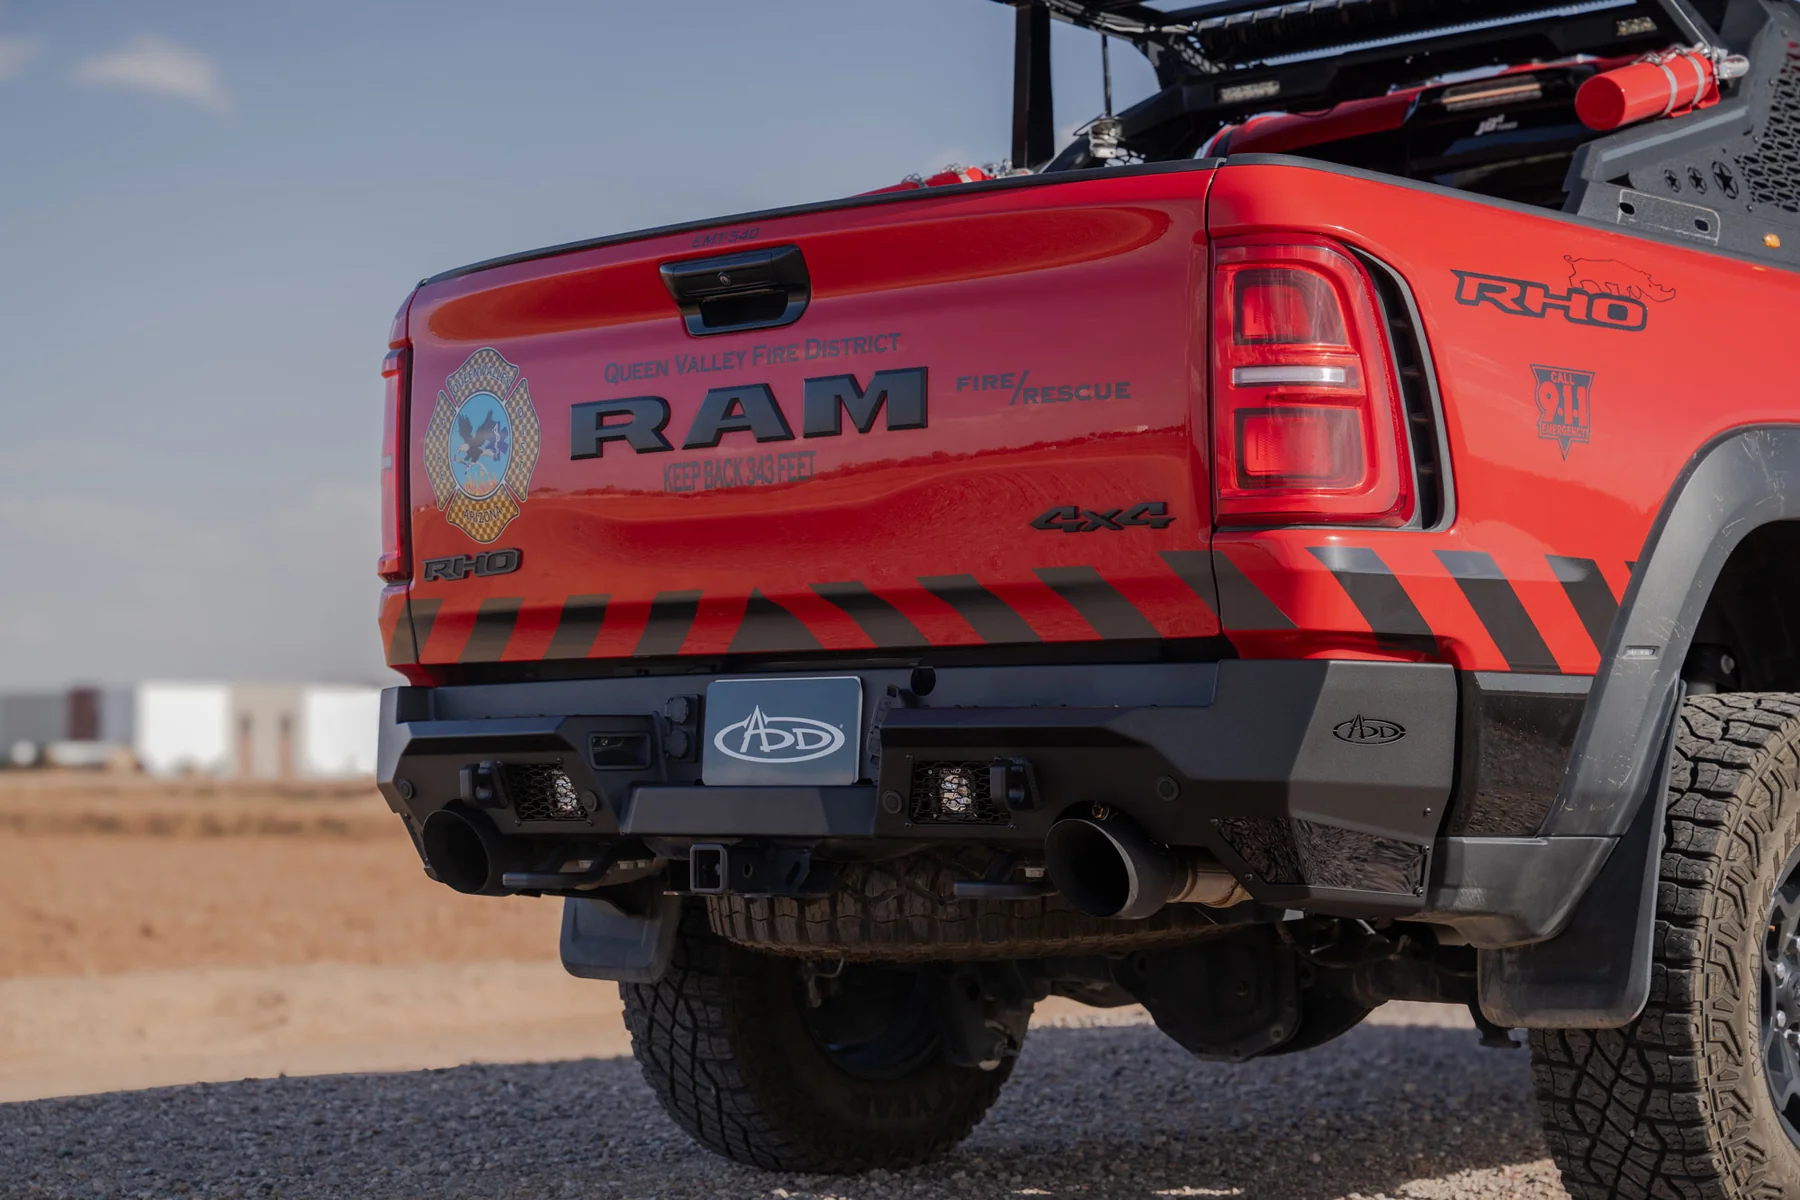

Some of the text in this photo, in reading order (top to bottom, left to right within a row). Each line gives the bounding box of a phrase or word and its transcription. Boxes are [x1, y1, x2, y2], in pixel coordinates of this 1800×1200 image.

[1450, 268, 1648, 332] RHO
[604, 332, 902, 385] QUEEN VALLEY FIRE DISTRICT
[1550, 371, 1576, 386] CALL
[570, 366, 928, 461] RAM
[1541, 423, 1588, 438] EMERGENCY
[663, 450, 817, 493] KEEP BACK 343 FEET
[463, 505, 503, 524] ARIZONA
[422, 548, 523, 582] RHO
